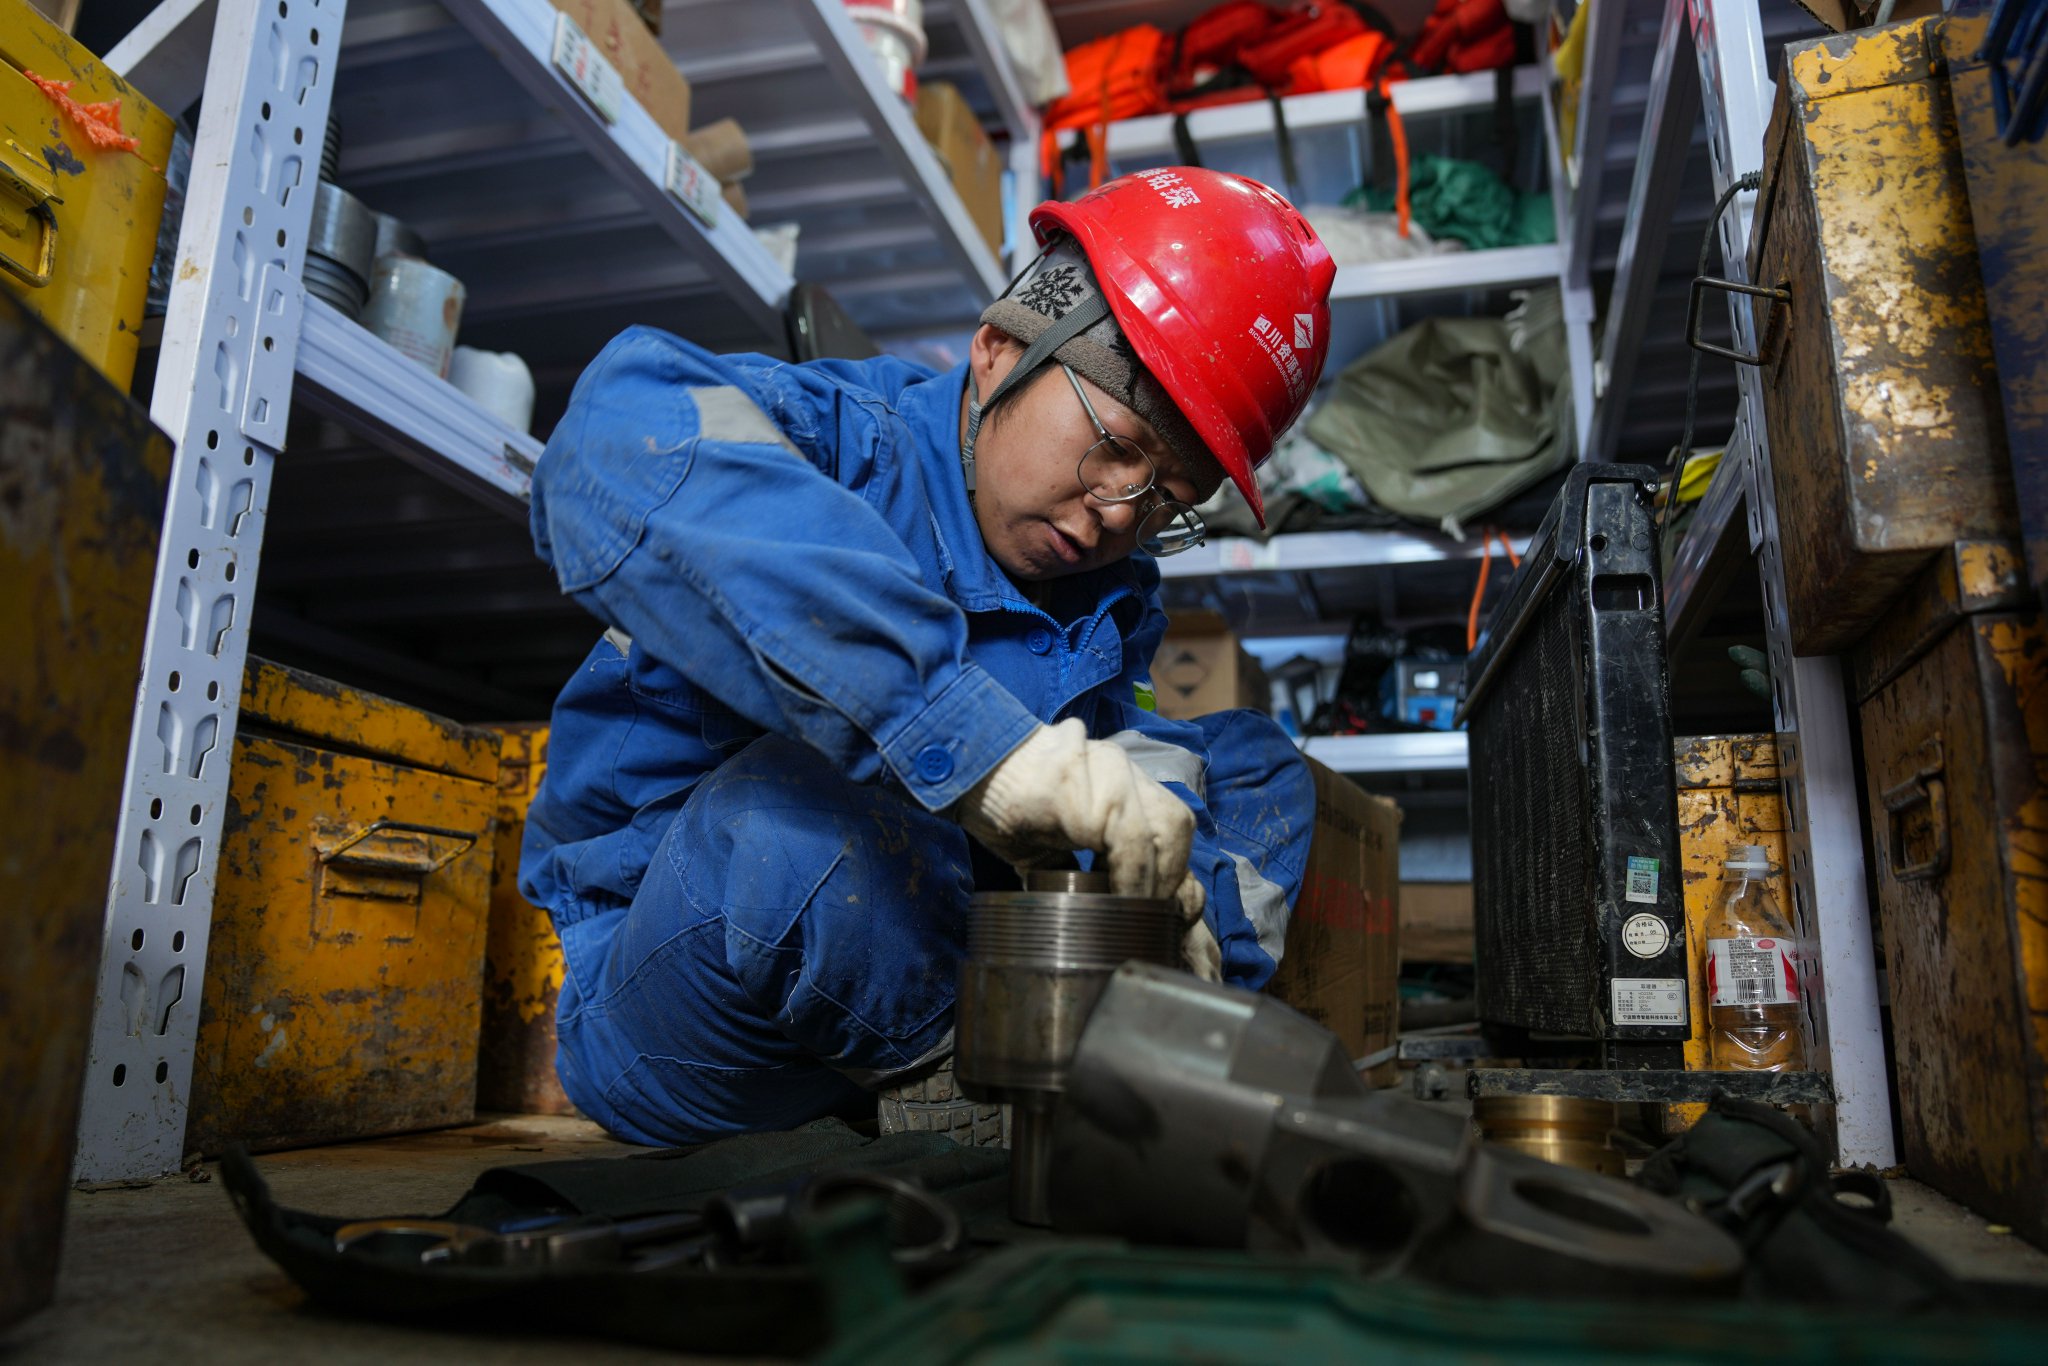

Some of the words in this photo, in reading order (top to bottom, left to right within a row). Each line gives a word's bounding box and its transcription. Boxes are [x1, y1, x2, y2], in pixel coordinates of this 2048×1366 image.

[1248, 327, 1272, 354] SICHUAN
[1253, 313, 1305, 399] 四川资源集团
